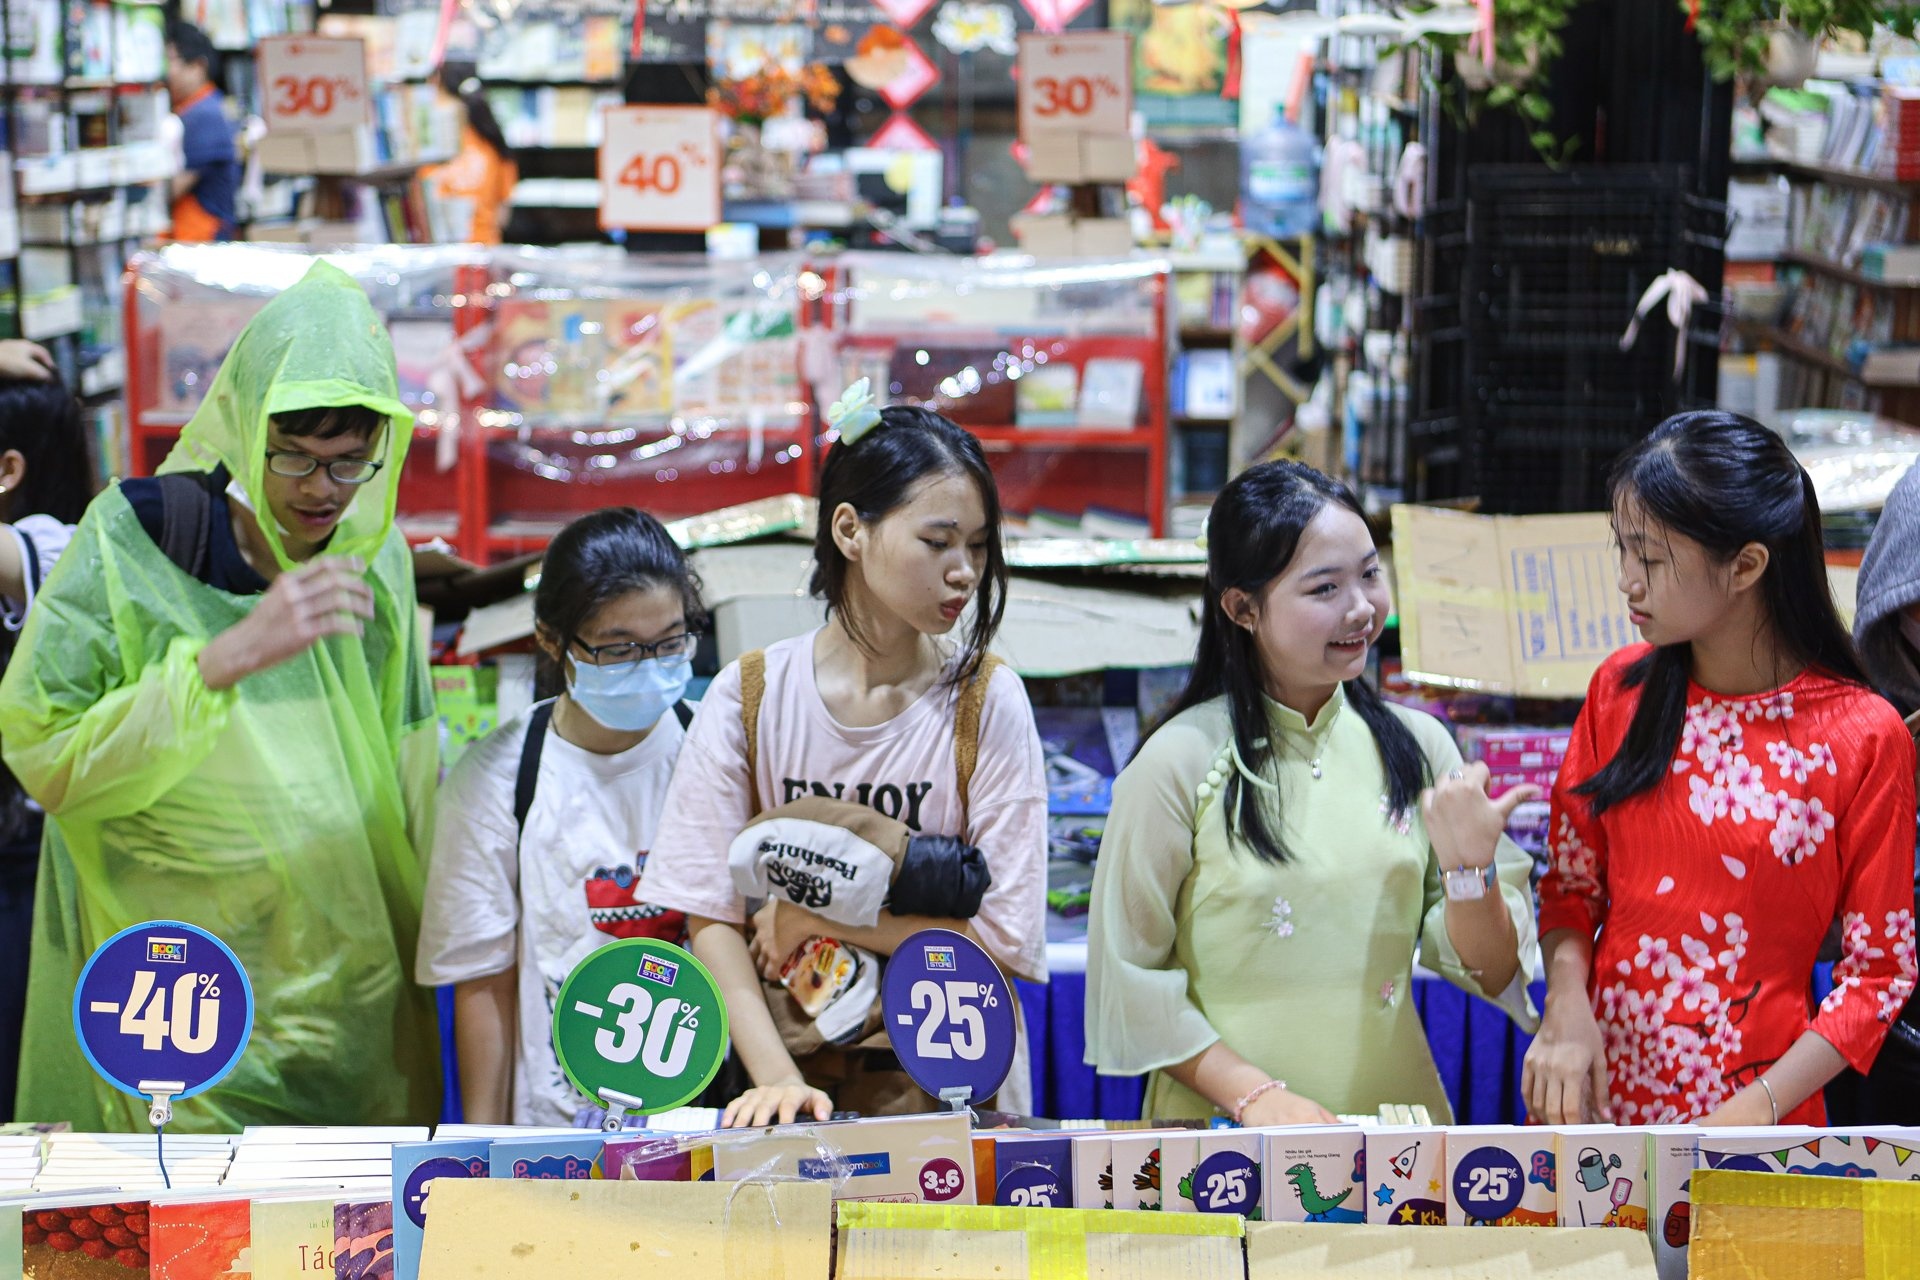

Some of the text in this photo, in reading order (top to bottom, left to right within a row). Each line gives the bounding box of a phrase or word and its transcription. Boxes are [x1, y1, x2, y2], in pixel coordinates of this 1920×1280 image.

[273, 74, 359, 117] 30%
[1032, 74, 1120, 117] 30%
[617, 141, 707, 195] 40%
[151, 953, 182, 961] STORE
[152, 943, 182, 955] BOOK
[928, 952, 951, 962] BOOK
[642, 969, 671, 983] STORE
[644, 960, 673, 978] BOOK
[91, 970, 221, 1054] -40%
[897, 980, 998, 1060] -25%
[574, 982, 701, 1078] -30%
[923, 1168, 961, 1190] 3-6
[1008, 1183, 1059, 1208] 25%
[1199, 1166, 1253, 1209] -25%
[1460, 1167, 1518, 1202] -25%
